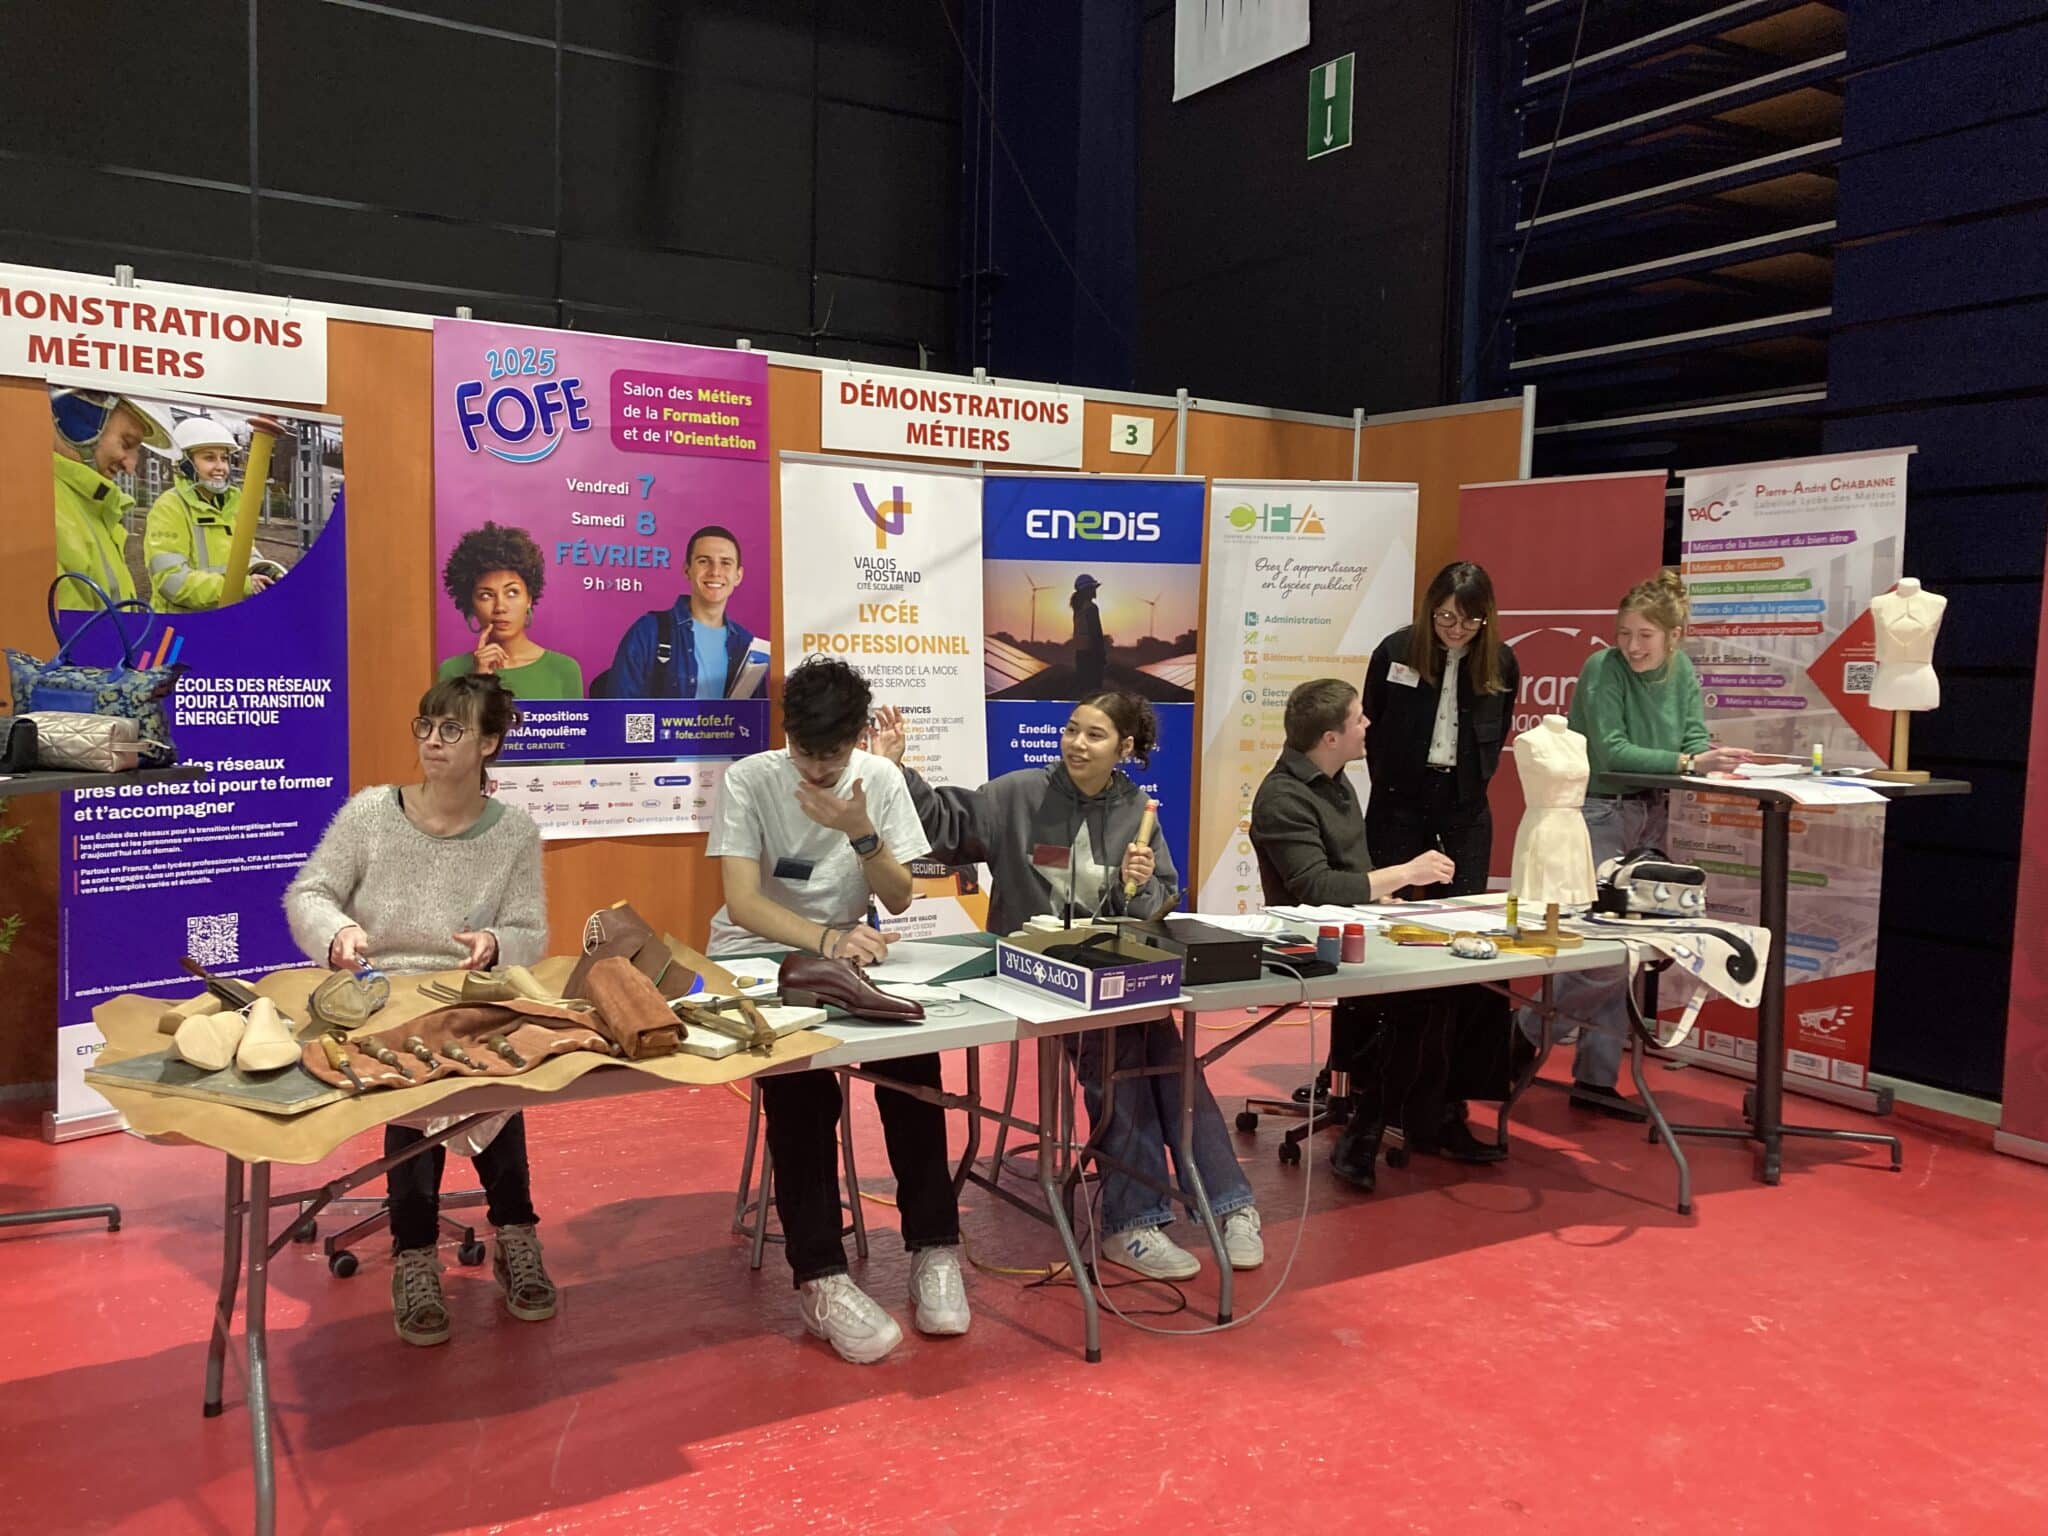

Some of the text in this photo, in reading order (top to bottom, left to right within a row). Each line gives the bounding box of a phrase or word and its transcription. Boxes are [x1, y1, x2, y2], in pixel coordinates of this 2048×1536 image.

[28, 333, 205, 379] MÉTIERS
[486, 347, 557, 380] 2025
[623, 381, 752, 406] Salon des Métiers
[840, 379, 1069, 425] DÉMONSTRATIONS
[455, 377, 591, 453] FOFE
[623, 404, 740, 427] de la Formation
[623, 427, 756, 450] et de l'Orientation
[906, 419, 1010, 452] MÉTIERS
[1125, 424, 1138, 445] 3
[566, 474, 656, 499] Vendredi 7
[1830, 477, 1896, 491] CHABANNE
[571, 511, 657, 536] Samedi 8
[1692, 534, 1849, 551] Métiers de la beauté et du bien être
[555, 538, 671, 569] FÉVRIER
[853, 556, 896, 571] VALOIS
[1691, 563, 1722, 572] Métiers
[1724, 562, 1735, 571] de
[865, 568, 921, 584] ROSTAND
[857, 580, 904, 591] CITÉ SCOLAIRE
[1262, 580, 1276, 590] en
[1279, 577, 1310, 599] lycées
[1723, 583, 1734, 592] de
[1736, 583, 1744, 591] la
[858, 600, 919, 624] LYCÉE
[1722, 605, 1733, 613] de
[1264, 615, 1331, 625] Administration
[802, 633, 969, 655] PROFESSIONNEL
[867, 664, 959, 675] MÉTIERS DE LA MODE
[176, 675, 331, 692] ÉCOLES DES RÉSEAUX
[885, 678, 926, 688] SERVICES
[176, 695, 324, 709] POUR LA TRANSITION
[176, 707, 279, 726] ÉNERGÉTIQUE
[523, 711, 590, 723] Expositions
[661, 714, 735, 728] www.fofe.fr
[675, 729, 735, 739] fofe.charente
[1019, 724, 1057, 734] Enedis
[527, 742, 565, 750] GRATUITE
[1010, 738, 1058, 748] à toutes
[217, 757, 285, 772] réseaux
[120, 784, 143, 797] de
[147, 782, 189, 796] chez
[193, 778, 216, 793] toi
[219, 778, 259, 792] pour
[261, 776, 277, 790] te
[279, 774, 333, 790] former
[74, 800, 235, 821] et t’accompagner
[80, 833, 94, 841] Les
[96, 831, 122, 840] Écoles
[124, 831, 138, 839] des
[140, 829, 169, 837] réseaux
[171, 828, 188, 836] pour
[197, 825, 230, 833] transition
[93, 842, 119, 850] jeunes
[1005, 951, 1079, 991] COPY STAR
[1161, 973, 1175, 986] A4
